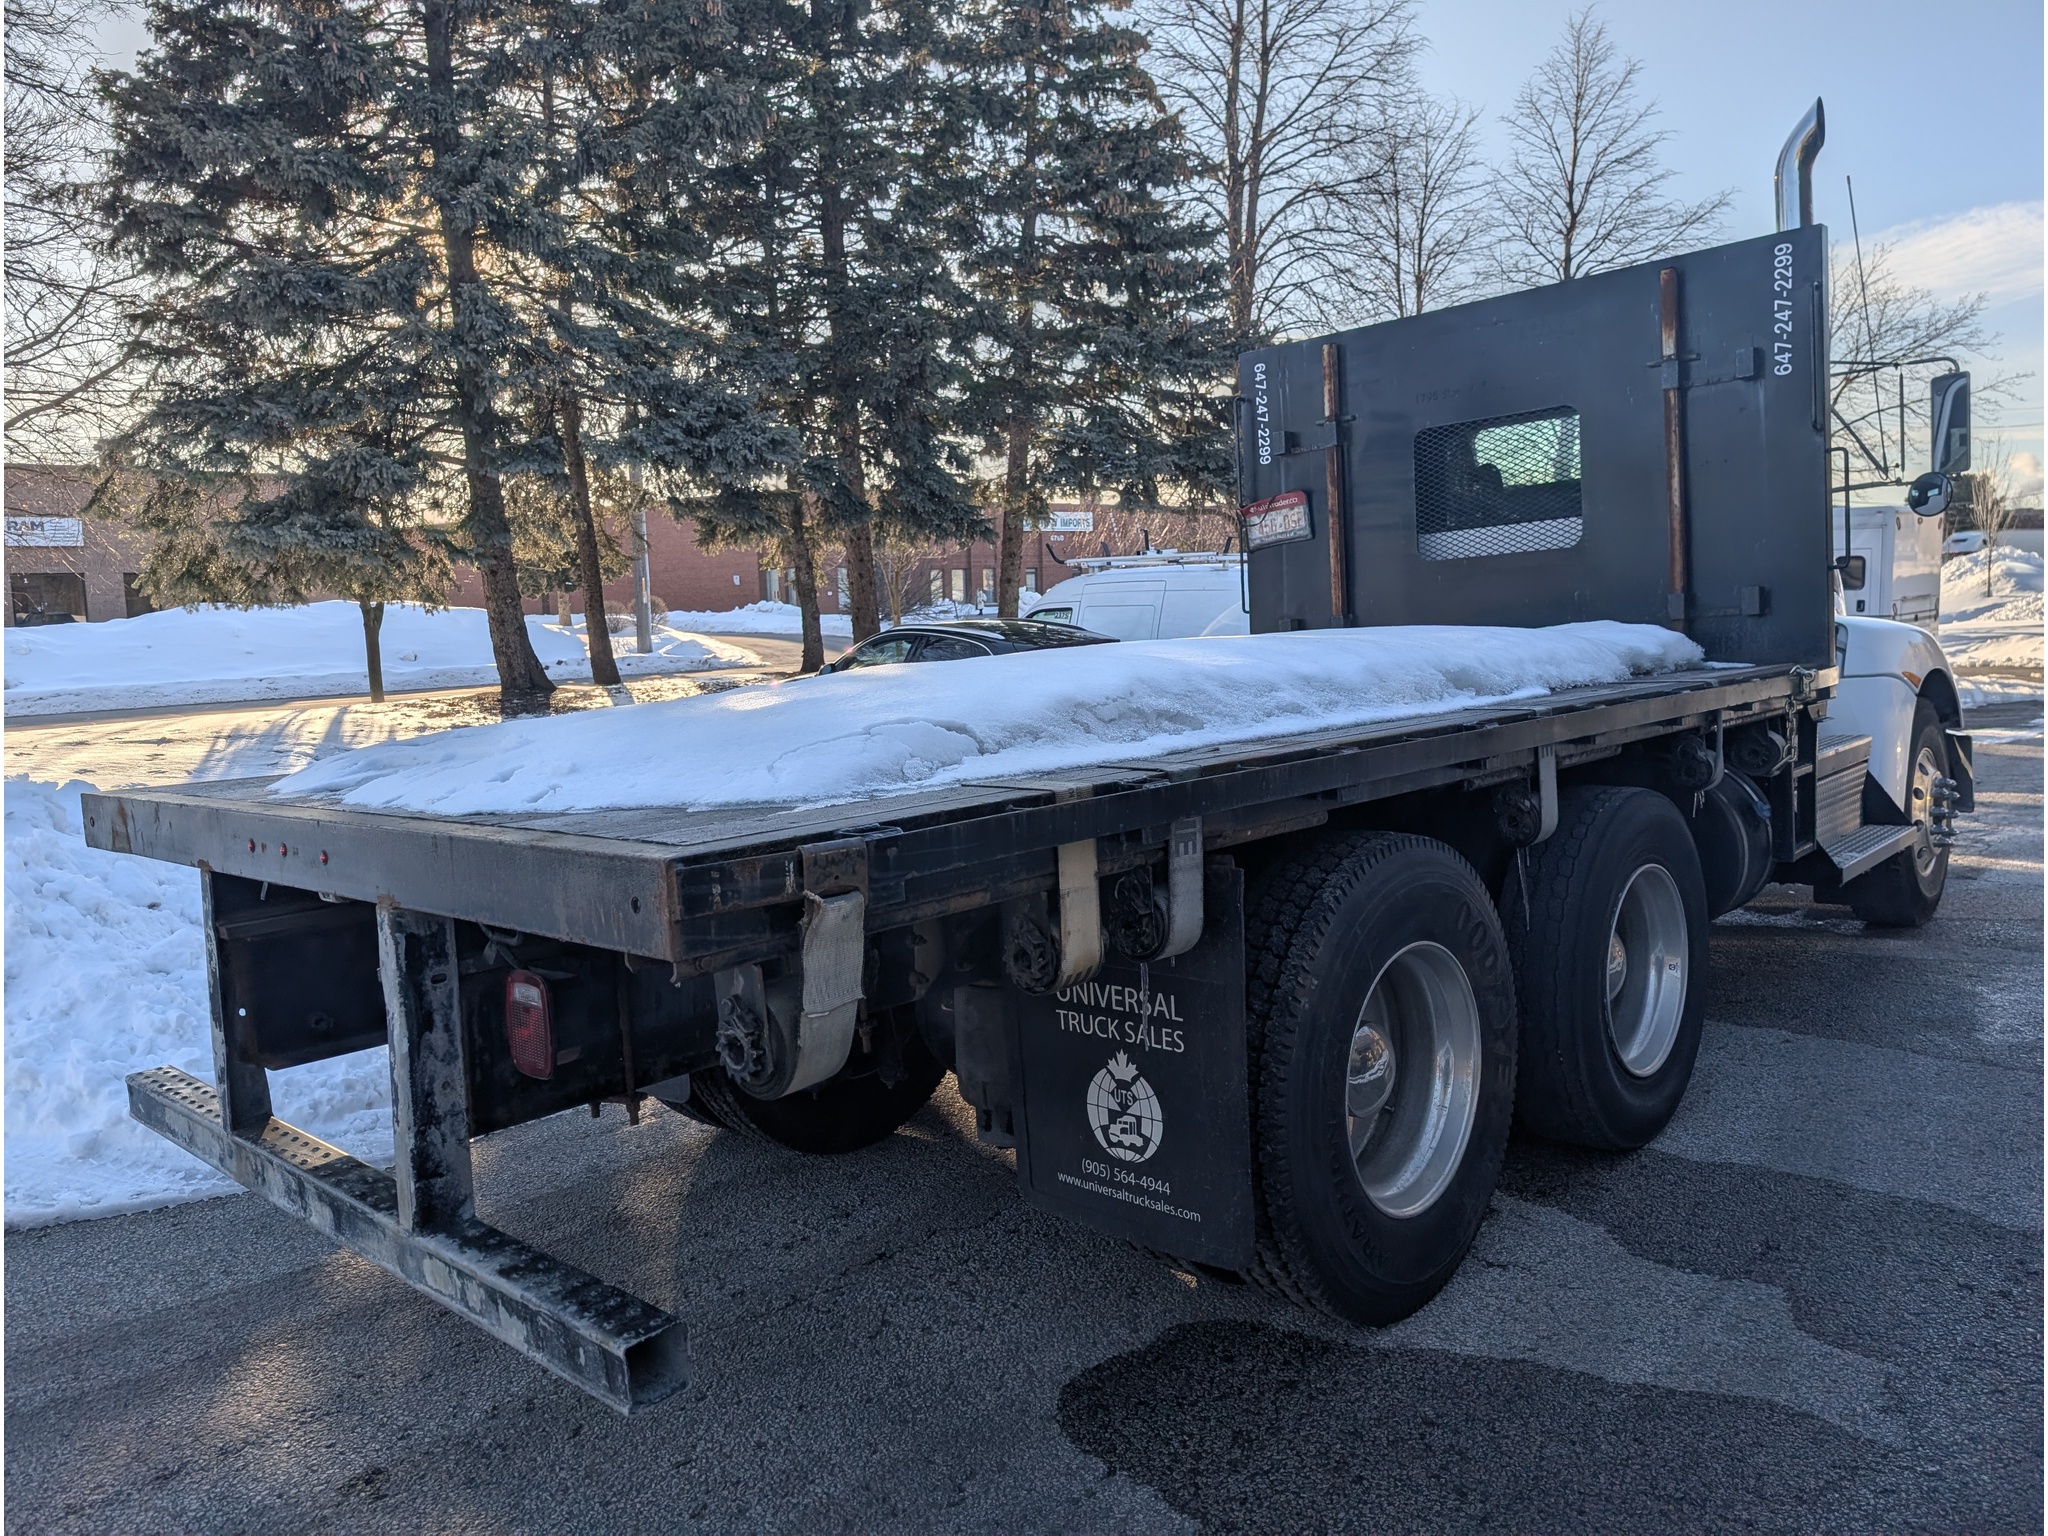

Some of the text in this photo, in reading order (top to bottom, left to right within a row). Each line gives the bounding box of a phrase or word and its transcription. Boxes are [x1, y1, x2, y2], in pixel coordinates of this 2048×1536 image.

[1774, 243, 1793, 376] 647-247-2299
[1254, 363, 1272, 465] 647-247-2299
[1055, 1009, 1185, 1053] TRUCK SALES
[1113, 1088, 1134, 1106] UTS
[1057, 1172, 1201, 1223] www.universaltrucksales.com
[1081, 1158, 1171, 1196] (905) 564-4944
